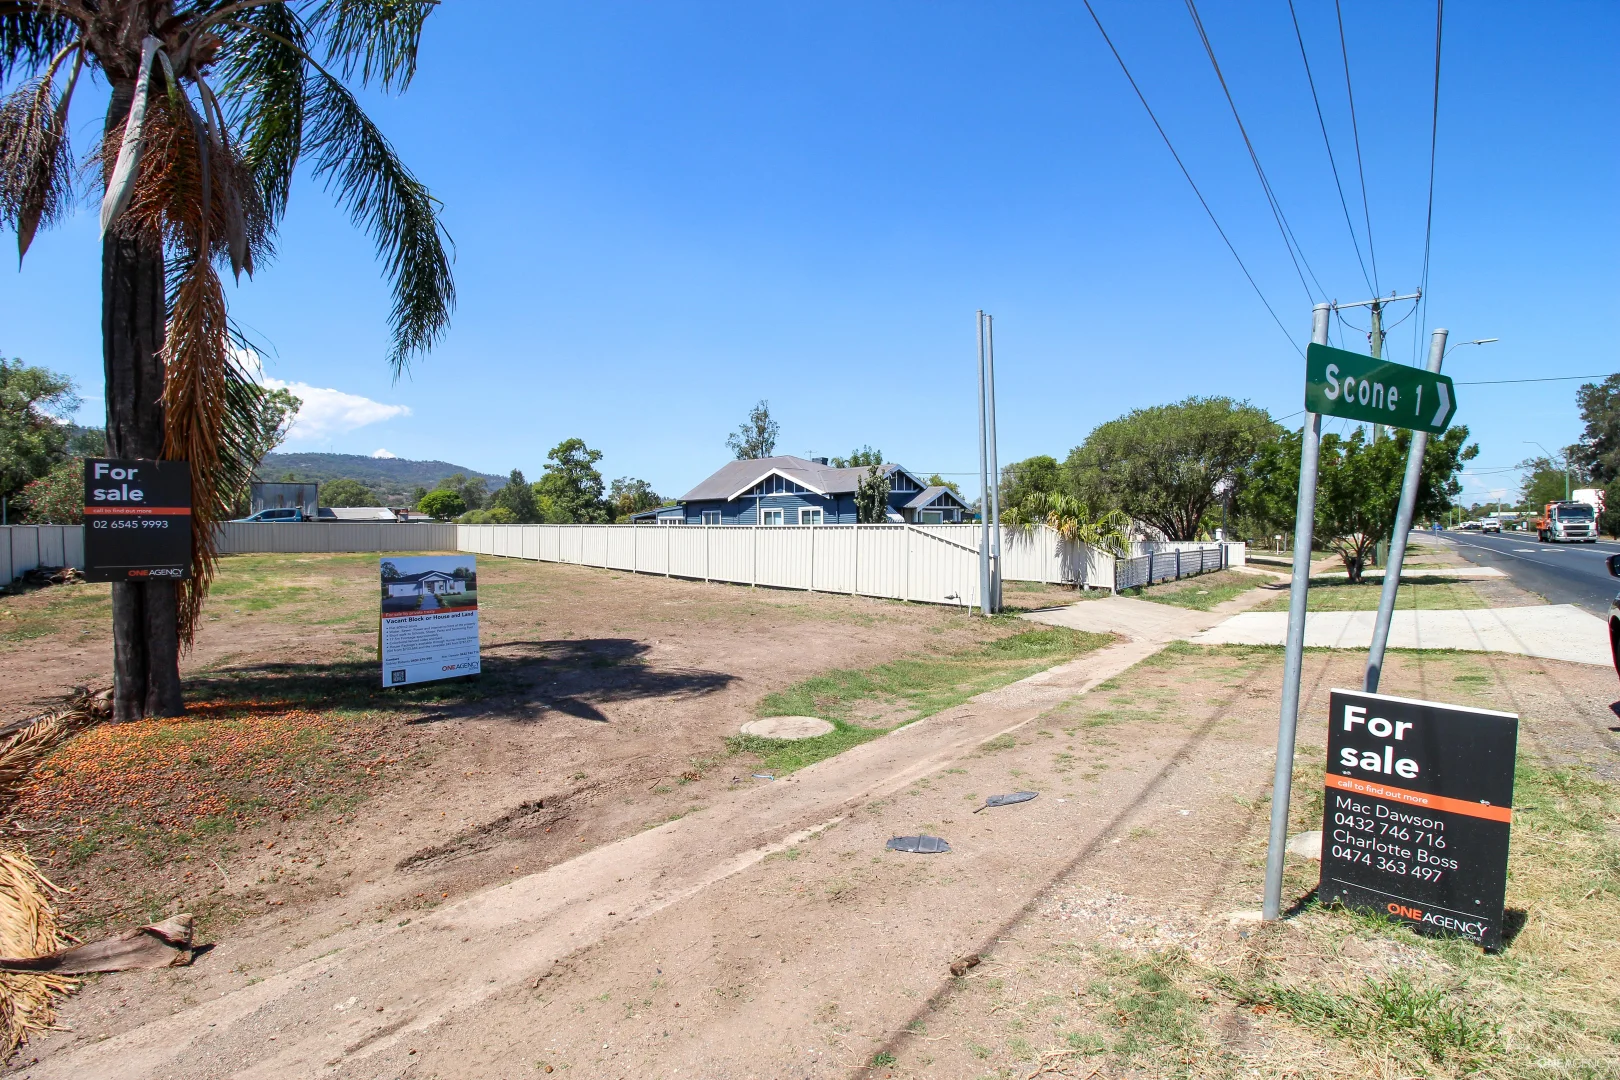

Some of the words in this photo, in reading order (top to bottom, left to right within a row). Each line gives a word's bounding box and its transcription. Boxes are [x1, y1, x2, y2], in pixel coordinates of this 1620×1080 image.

[1324, 363, 1398, 411] Scone
[1415, 384, 1422, 416] 1
[94, 463, 138, 480] For
[93, 484, 144, 501] sale
[93, 521, 108, 529] 02
[111, 521, 139, 529] 6545
[141, 521, 169, 529] 9993
[1343, 704, 1413, 741] For
[1340, 745, 1419, 779] sale
[1337, 780, 1353, 789] call
[1354, 783, 1364, 791] to
[1366, 784, 1384, 795] find
[1385, 790, 1401, 799] out
[1403, 794, 1428, 805] more
[1334, 812, 1374, 833] 0432
[1379, 822, 1409, 841] 746
[1414, 830, 1446, 849] 716
[1336, 795, 1371, 815] Mac
[1376, 804, 1444, 831] Dawson
[1332, 845, 1372, 866] 0474
[1376, 856, 1406, 875] 363
[1411, 865, 1442, 883] 497
[1333, 829, 1411, 859] Charlotte
[1417, 848, 1458, 870] Boss
